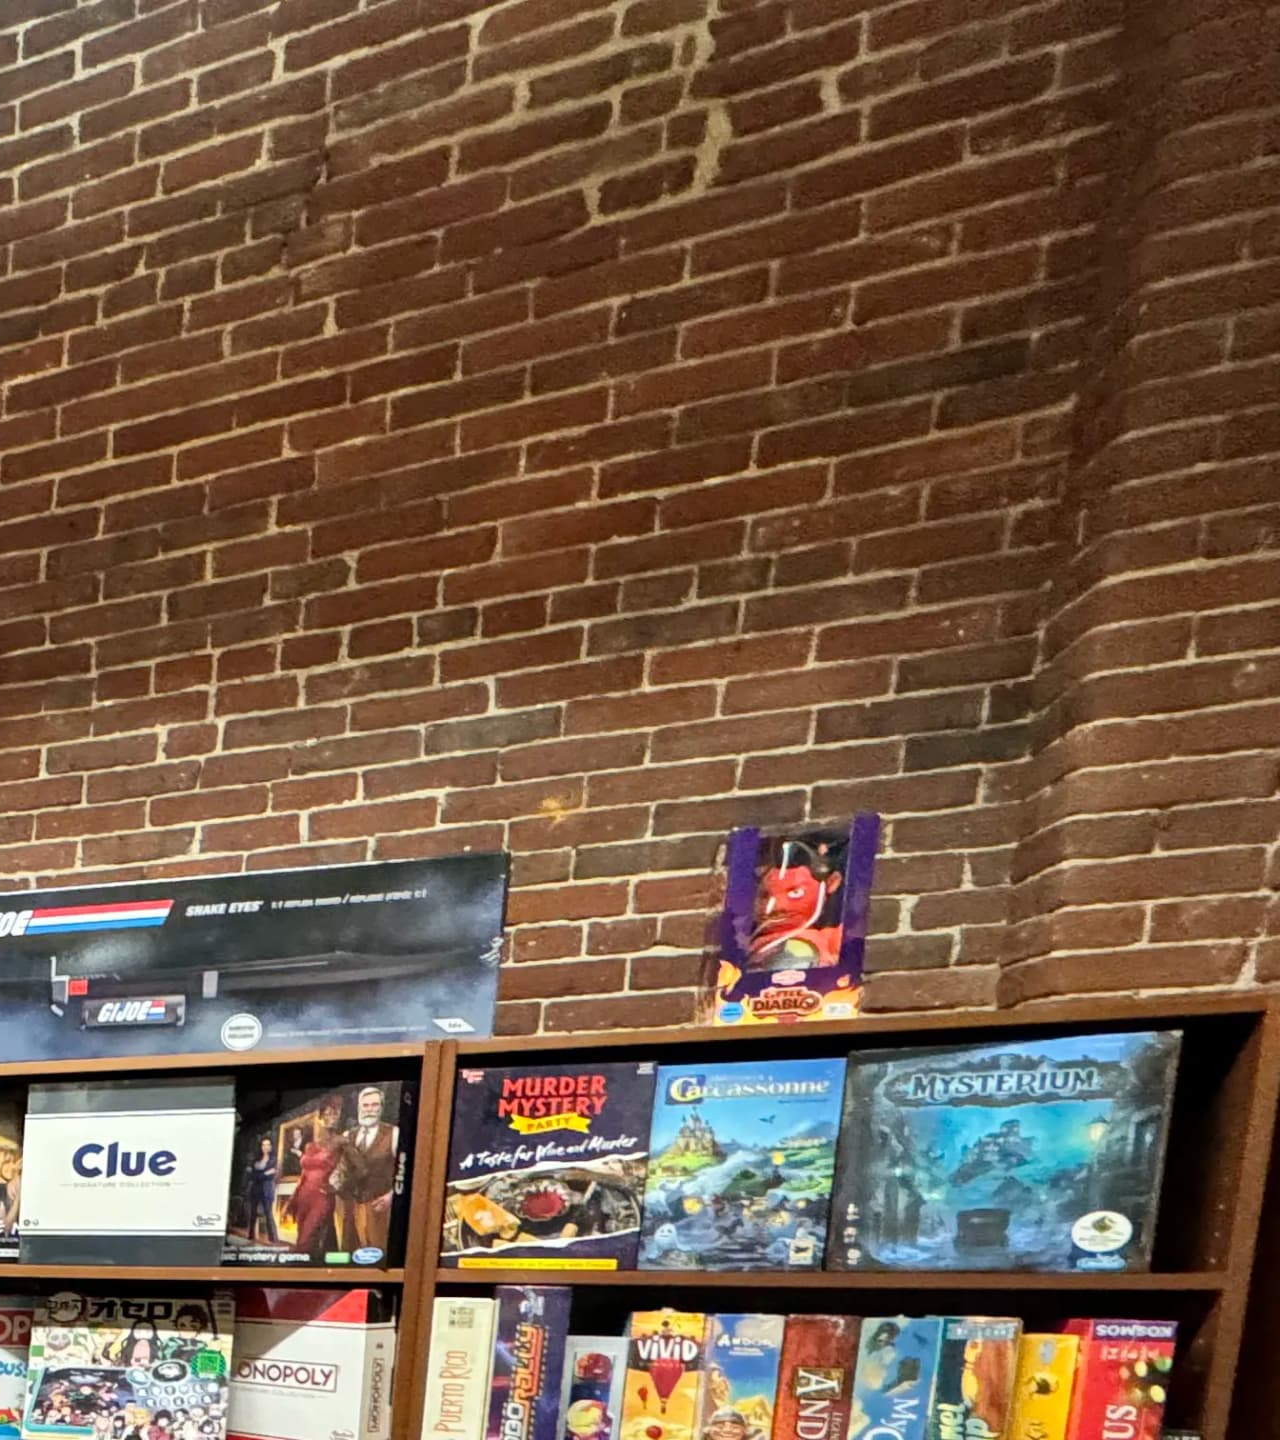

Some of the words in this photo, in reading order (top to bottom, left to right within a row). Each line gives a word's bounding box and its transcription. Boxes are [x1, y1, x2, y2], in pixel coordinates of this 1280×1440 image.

[186, 902, 226, 917] SNAKE
[502, 1075, 607, 1097] MURDER
[670, 1077, 830, 1102] Carcassonne
[908, 1068, 1099, 1100] MYSTERIUM
[498, 1096, 608, 1117] MYSTERY
[527, 1117, 571, 1132] PARTY
[72, 1141, 178, 1179] Clue
[476, 1150, 511, 1166] Taste
[511, 1145, 534, 1168] for
[589, 1134, 638, 1152] Murder
[394, 1152, 407, 1195] Clue
[239, 1252, 278, 1262] mystery
[278, 1252, 310, 1262] game
[89, 1301, 173, 1320] オセロ
[1095, 1324, 1173, 1338] KOSMOS
[238, 1359, 333, 1390] ONOPOLY
[439, 1350, 469, 1380] RICO
[370, 1360, 384, 1432] MONOPOLY
[435, 1382, 466, 1434] PUERTO
